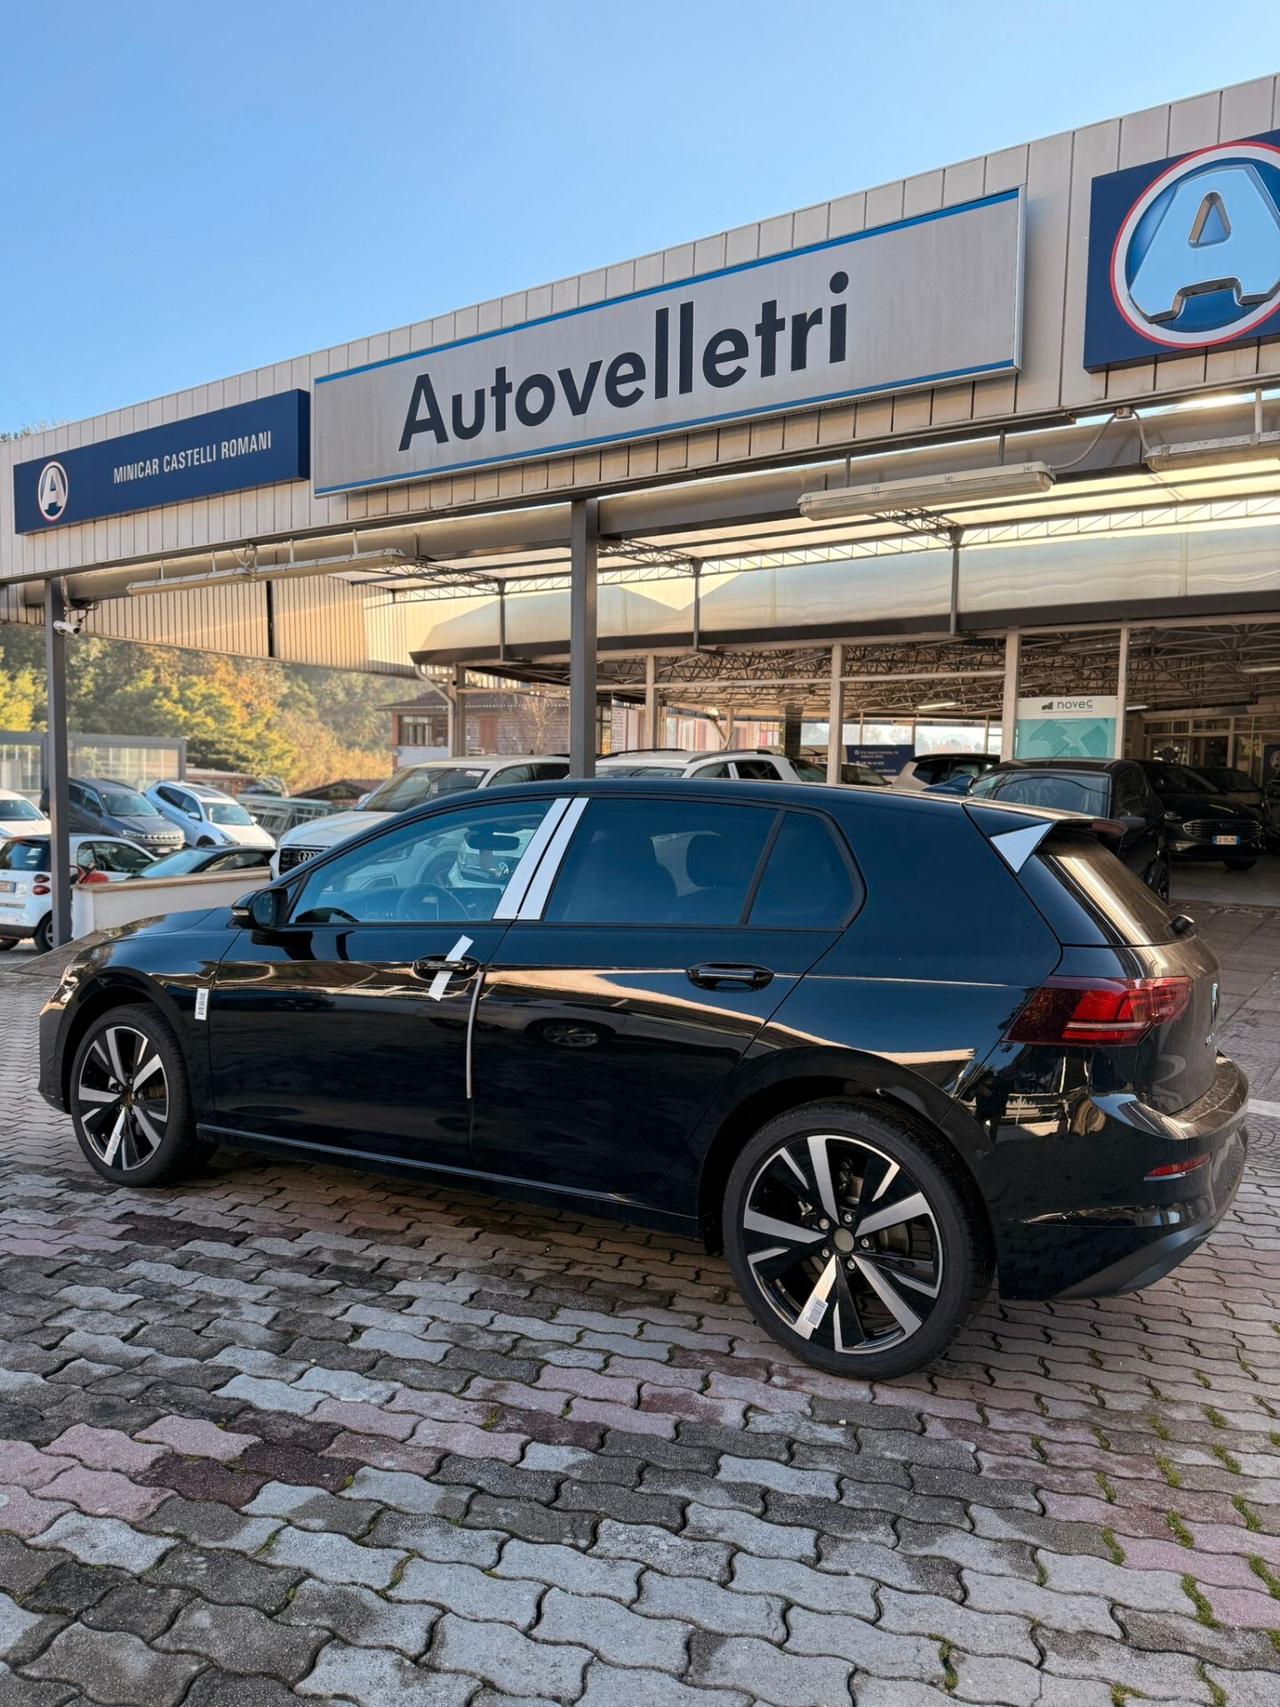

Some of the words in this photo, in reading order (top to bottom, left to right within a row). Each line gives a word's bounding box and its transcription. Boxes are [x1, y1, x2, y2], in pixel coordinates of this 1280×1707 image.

[398, 271, 849, 452] Autovelletri
[113, 458, 159, 484] MINICAR
[163, 444, 217, 473] CASTELLI
[221, 430, 272, 460] ROMANI
